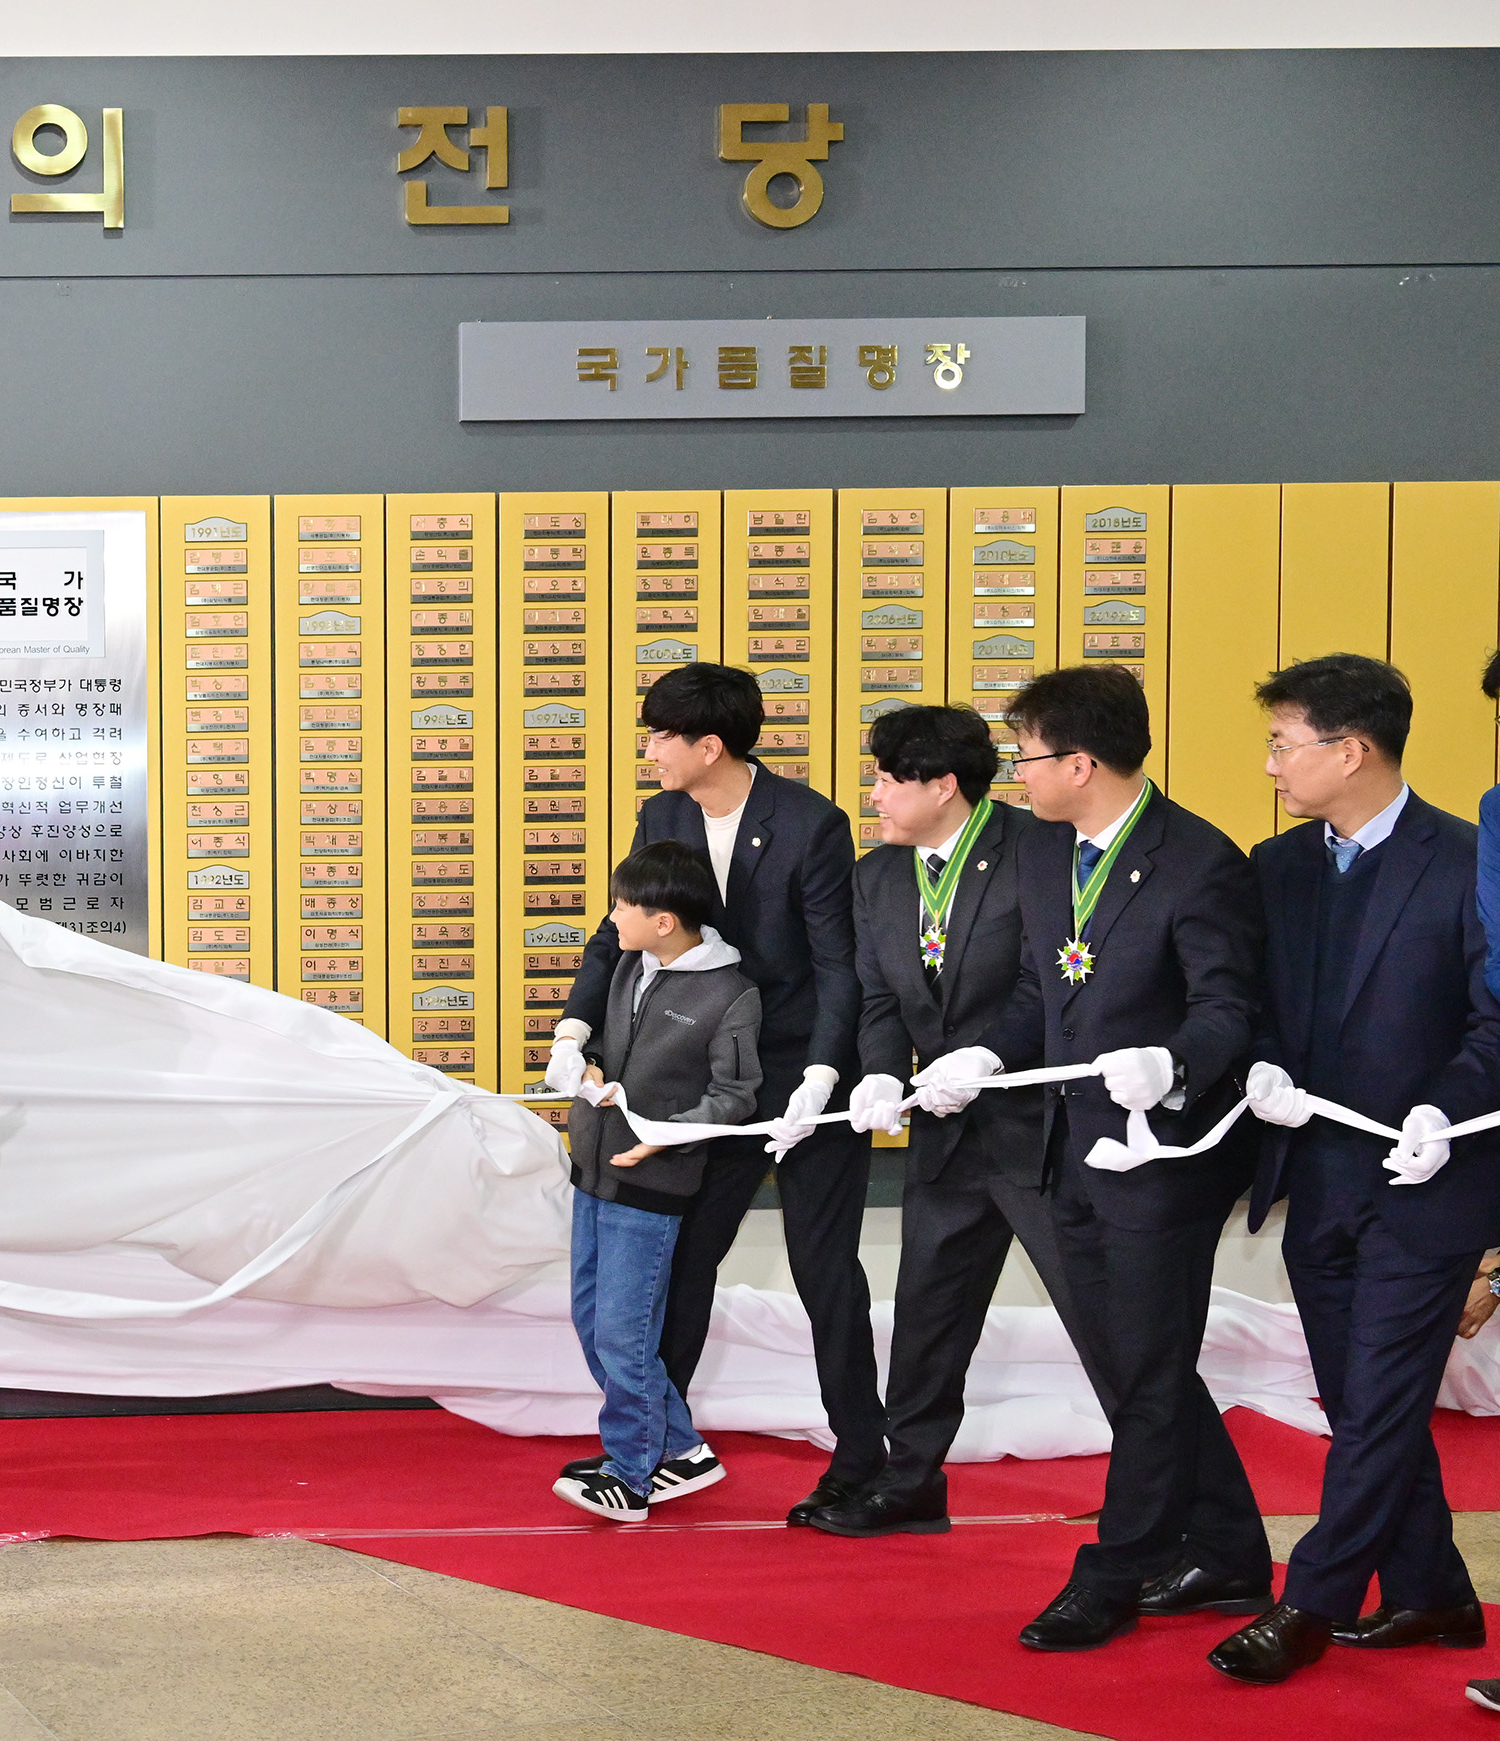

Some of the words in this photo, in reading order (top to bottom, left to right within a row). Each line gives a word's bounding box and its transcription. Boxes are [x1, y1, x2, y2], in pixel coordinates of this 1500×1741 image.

[191, 526, 242, 538] 1991년도
[24, 645, 50, 655] Master
[53, 645, 61, 654] of
[63, 645, 90, 655] Quality
[80, 679, 122, 692] 대통령
[17, 703, 65, 717] 증서와
[76, 703, 122, 717] 명장패
[18, 728, 81, 741] 수여하고
[92, 727, 122, 741] 격려
[59, 751, 122, 766] 산업현장
[1, 776, 82, 790] 장인정신이
[92, 776, 122, 789] 투철
[2, 801, 48, 814] 혁신적
[58, 801, 123, 814] 업무개선
[31, 825, 123, 839] 후진양성으로
[2, 849, 49, 863] 사회에
[59, 848, 124, 863] 이바지한
[19, 873, 67, 887] 뚜렷한
[76, 873, 123, 886] 귀감이
[194, 874, 244, 885] 1992년도
[528, 987, 561, 999] 오정
